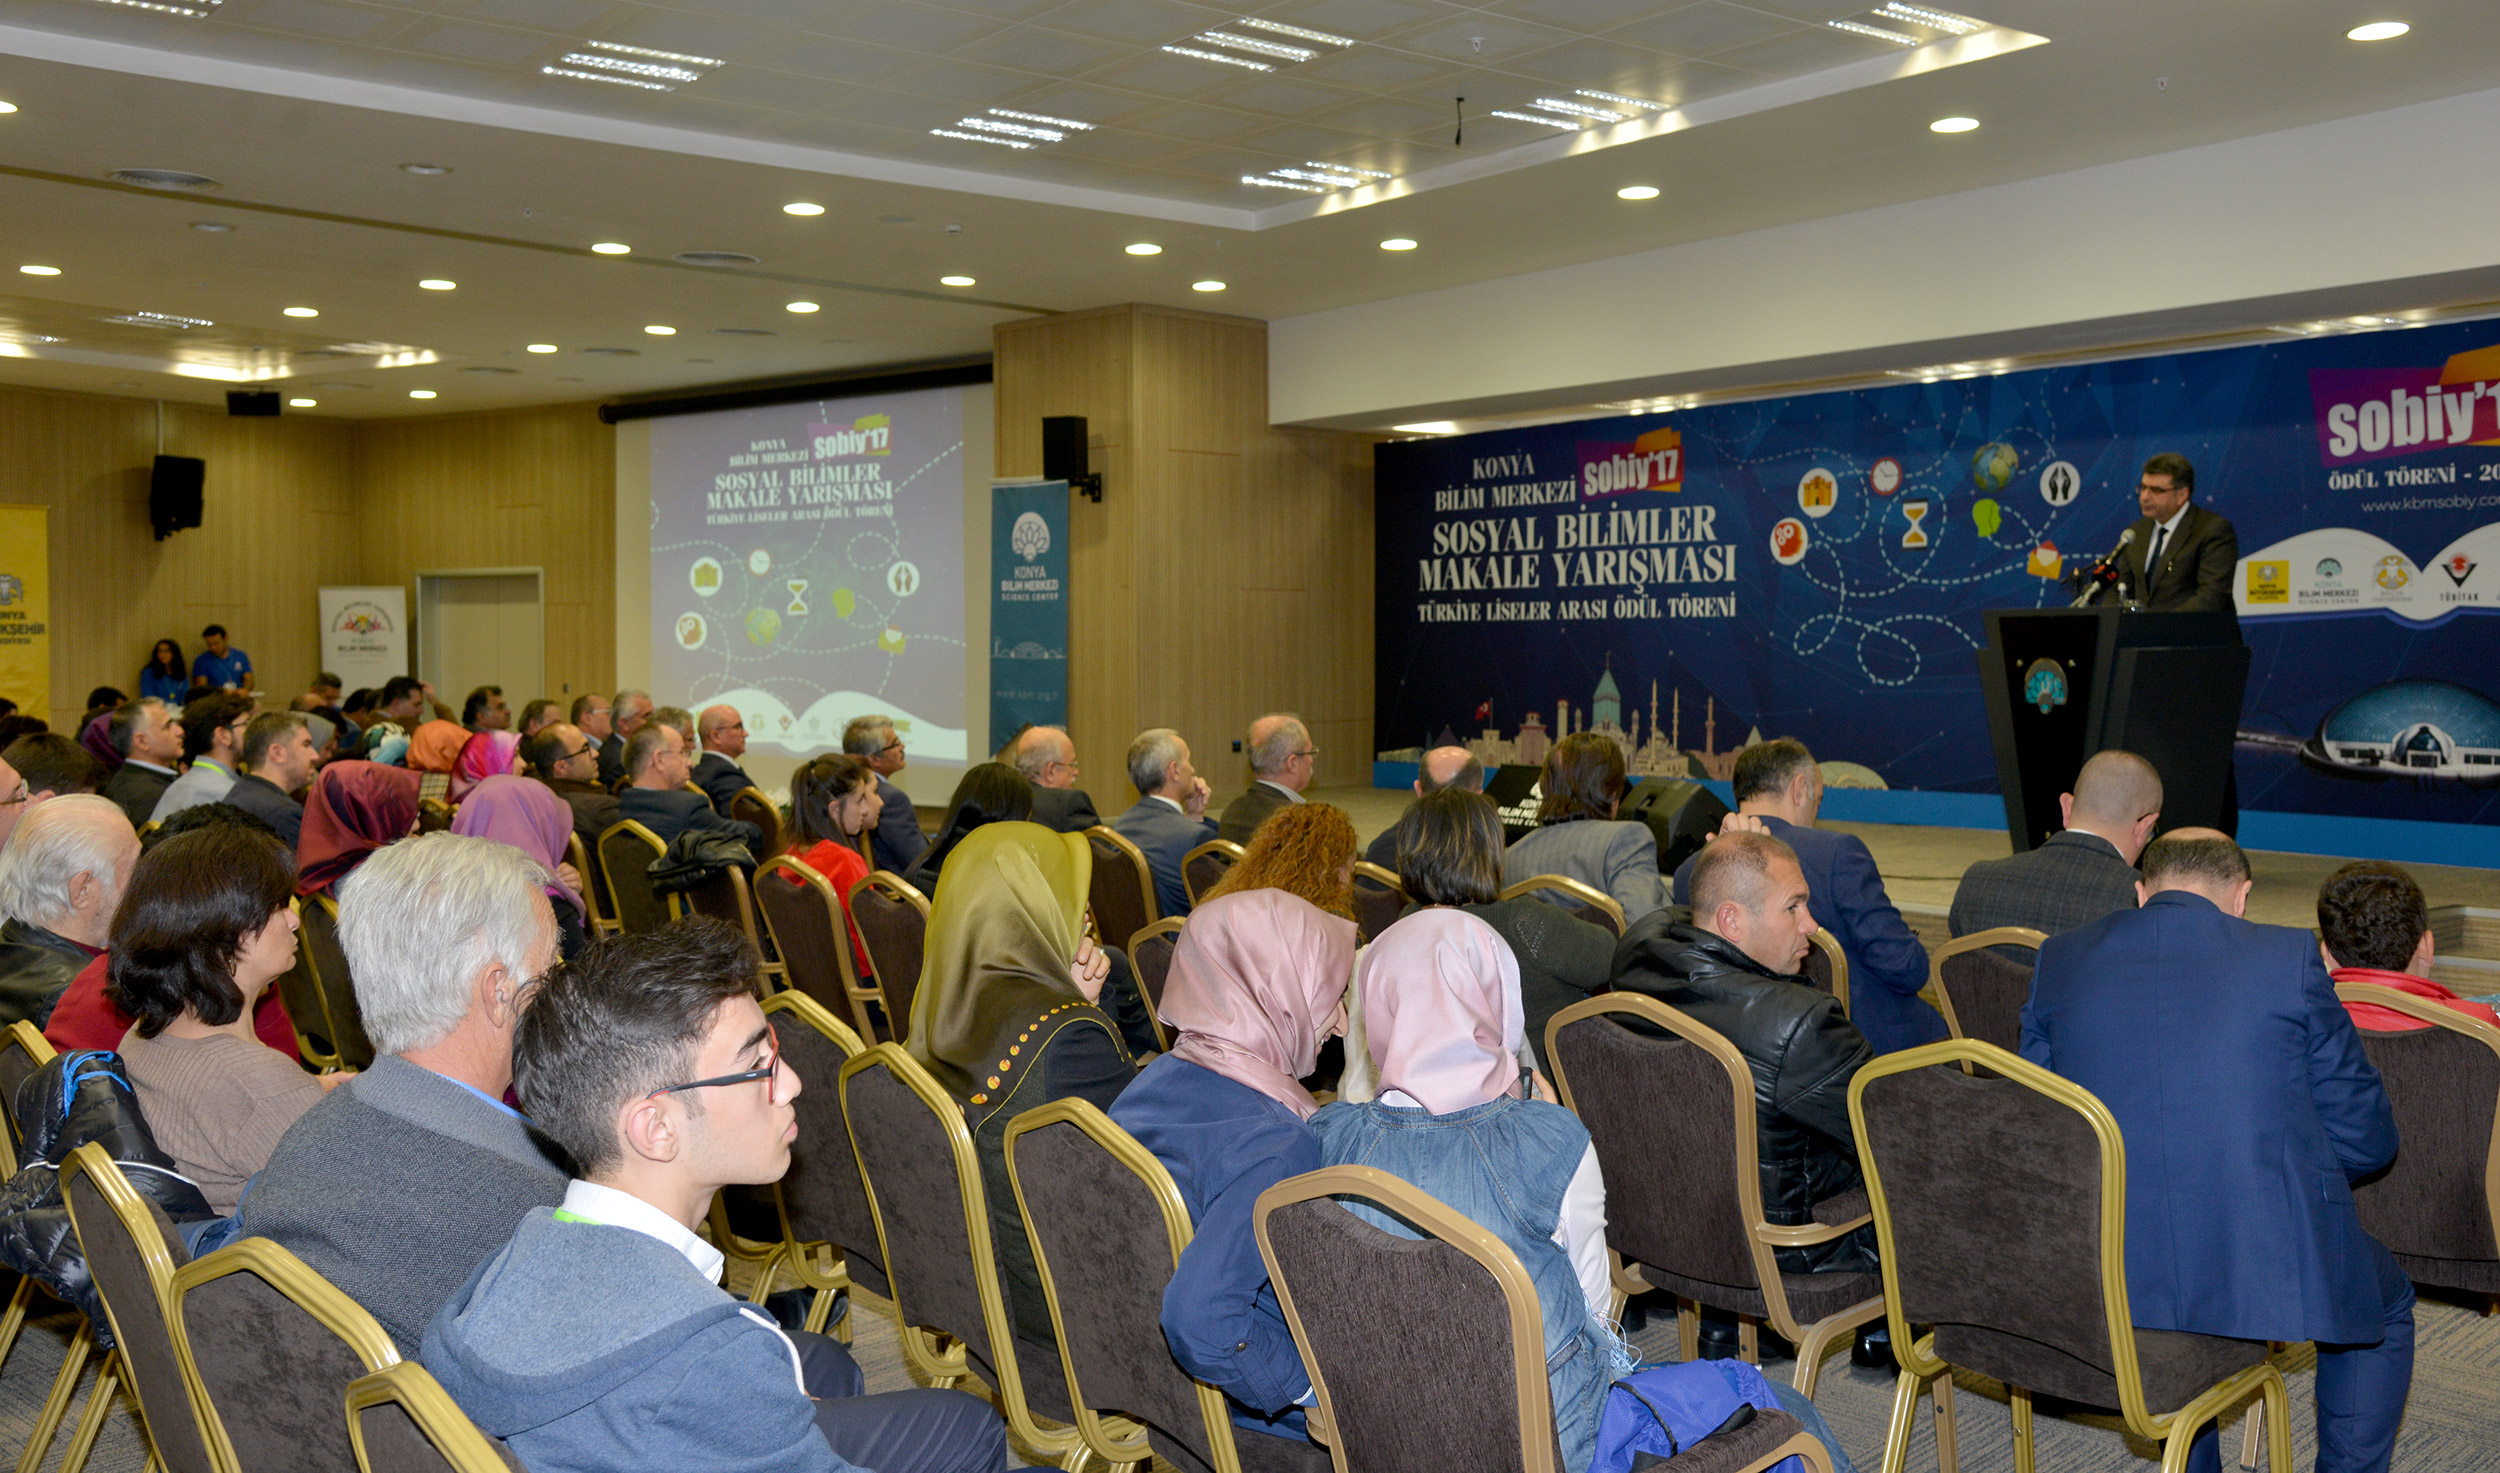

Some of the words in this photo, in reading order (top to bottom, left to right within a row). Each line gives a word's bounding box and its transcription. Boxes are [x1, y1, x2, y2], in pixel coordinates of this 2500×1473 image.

[729, 450, 758, 467] BİLİM
[762, 448, 809, 464] MERKEZİ
[751, 438, 786, 452] KONYA
[715, 470, 783, 492] SOSYAL
[790, 462, 881, 487] BİLİMLER
[1472, 453, 1535, 480] KONYA
[1583, 449, 1679, 497] sobiy'17
[2328, 468, 2379, 490] ÖDÜL
[2384, 462, 2456, 487] TÖRENİ
[706, 488, 781, 510] MAKALE
[788, 480, 893, 508] YARIŞMASI
[1435, 485, 1484, 512] BİLİM
[1491, 474, 1577, 508] MERKEZİ
[1433, 517, 1544, 556] SOSYAL
[1556, 501, 1718, 550] BİLİMLER
[1014, 566, 1047, 579] KONYA
[1418, 554, 1540, 592] MAKALE
[1552, 545, 1738, 594] YARIŞMASI
[1418, 600, 1481, 622] TÜRKİYE
[1486, 598, 1551, 622] LİSELER
[1557, 600, 1608, 620] ARASI
[1613, 594, 1662, 619] ÖDÜL
[1668, 591, 1737, 618] TÖRENİ
[2440, 592, 2479, 602] TÜBİTAK
